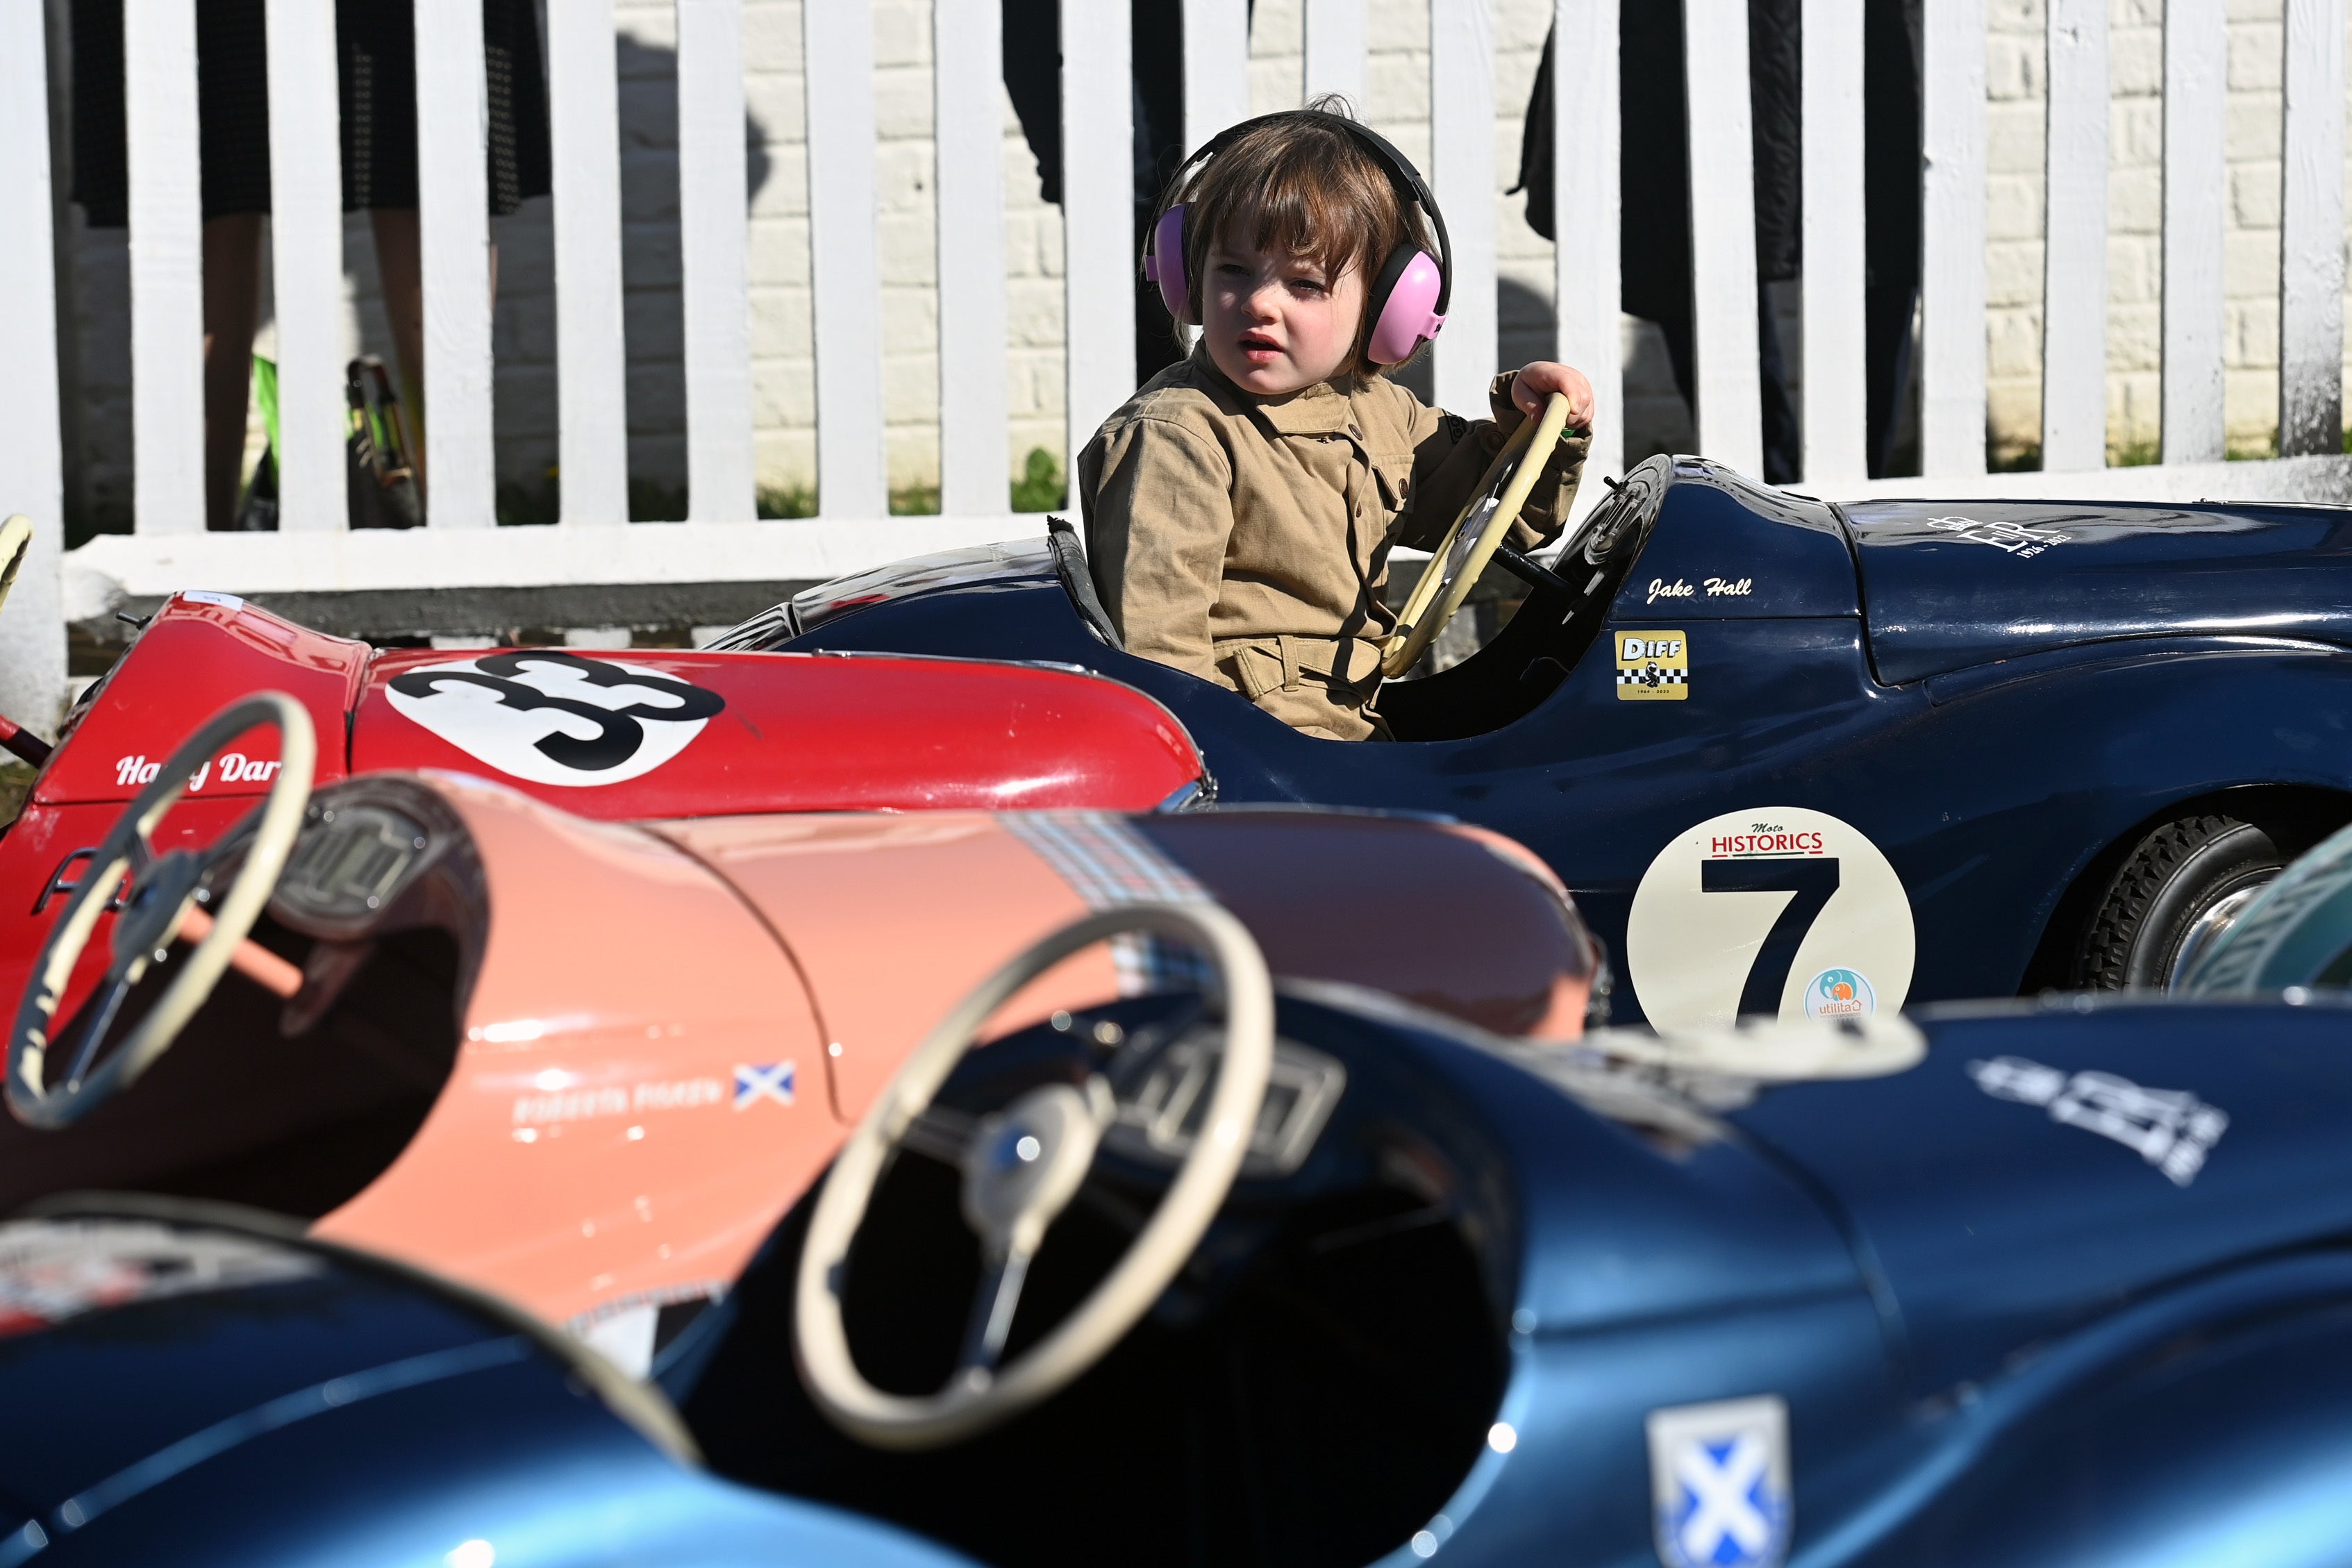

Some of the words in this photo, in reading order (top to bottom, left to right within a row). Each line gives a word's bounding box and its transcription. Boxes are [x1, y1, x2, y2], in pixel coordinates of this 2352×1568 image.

[2016, 546, 2045, 559] 1926
[2046, 535, 2073, 547] 2022
[1646, 578, 1694, 605] Jake
[1703, 577, 1752, 597] Hall
[388, 651, 725, 771] 33
[115, 755, 211, 792] Hay
[219, 753, 285, 783] Dar
[1751, 823, 1784, 833] Moto
[1712, 832, 1823, 853] HISTORICS
[1701, 858, 1840, 1028] 7
[1819, 1003, 1851, 1014] utilita
